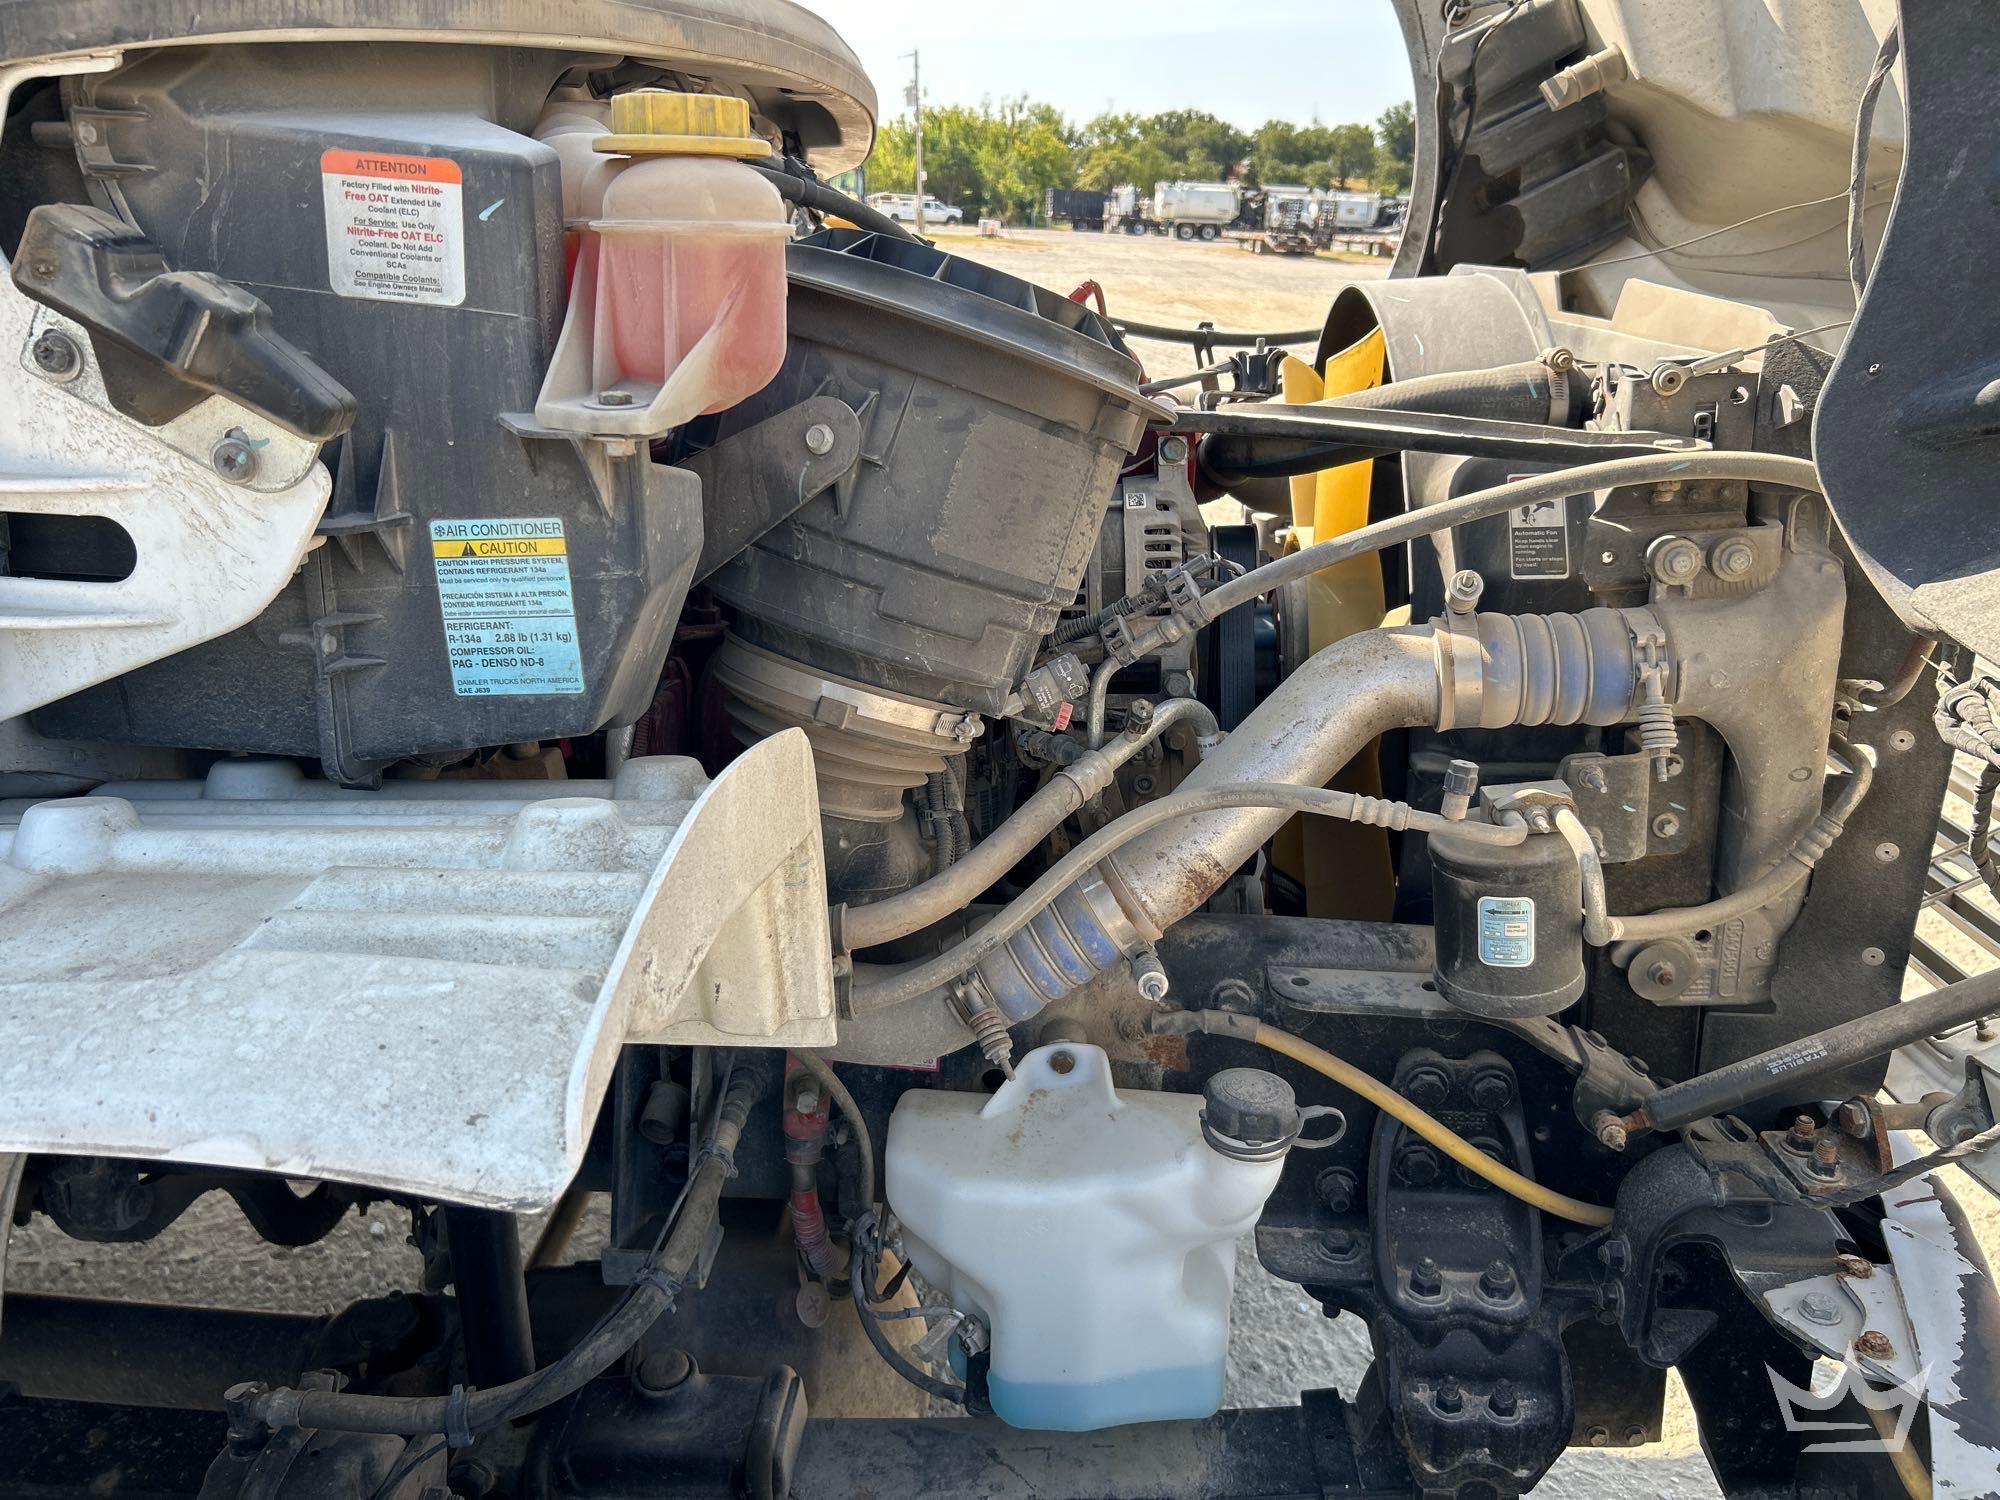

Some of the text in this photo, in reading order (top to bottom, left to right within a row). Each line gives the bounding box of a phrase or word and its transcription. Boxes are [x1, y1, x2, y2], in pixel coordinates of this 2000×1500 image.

[356, 159, 426, 174] ATTENTION
[342, 180, 443, 195] Factory Filled with Nitrite-
[345, 191, 366, 202] Free
[368, 193, 388, 203] OAT
[390, 197, 426, 206] Extended
[368, 205, 420, 218] Coolant (ELC)
[354, 216, 435, 231] For Service: Use Only
[347, 226, 443, 242] Nitrite-Free OAT ELC
[359, 240, 388, 248] Coolant.
[350, 248, 398, 258] Conventional
[400, 252, 432, 262] Coolants
[386, 261, 406, 269] SCAs
[355, 270, 440, 284] Compatible Coolants:
[368, 281, 391, 290] Engine
[447, 522, 562, 536] AIR CONDITIONER
[480, 542, 538, 554] CAUTION
[446, 622, 514, 630] REFRIGERANT:
[448, 632, 572, 644] R-134a 2.88 lb (1.31 kg)
[450, 646, 535, 656] COMPRESSOR OIL:
[452, 659, 472, 668] PAG
[482, 658, 518, 668] DENSO
[520, 658, 544, 666] ND-8
[1771, 1050, 1828, 1074] STABILUS
